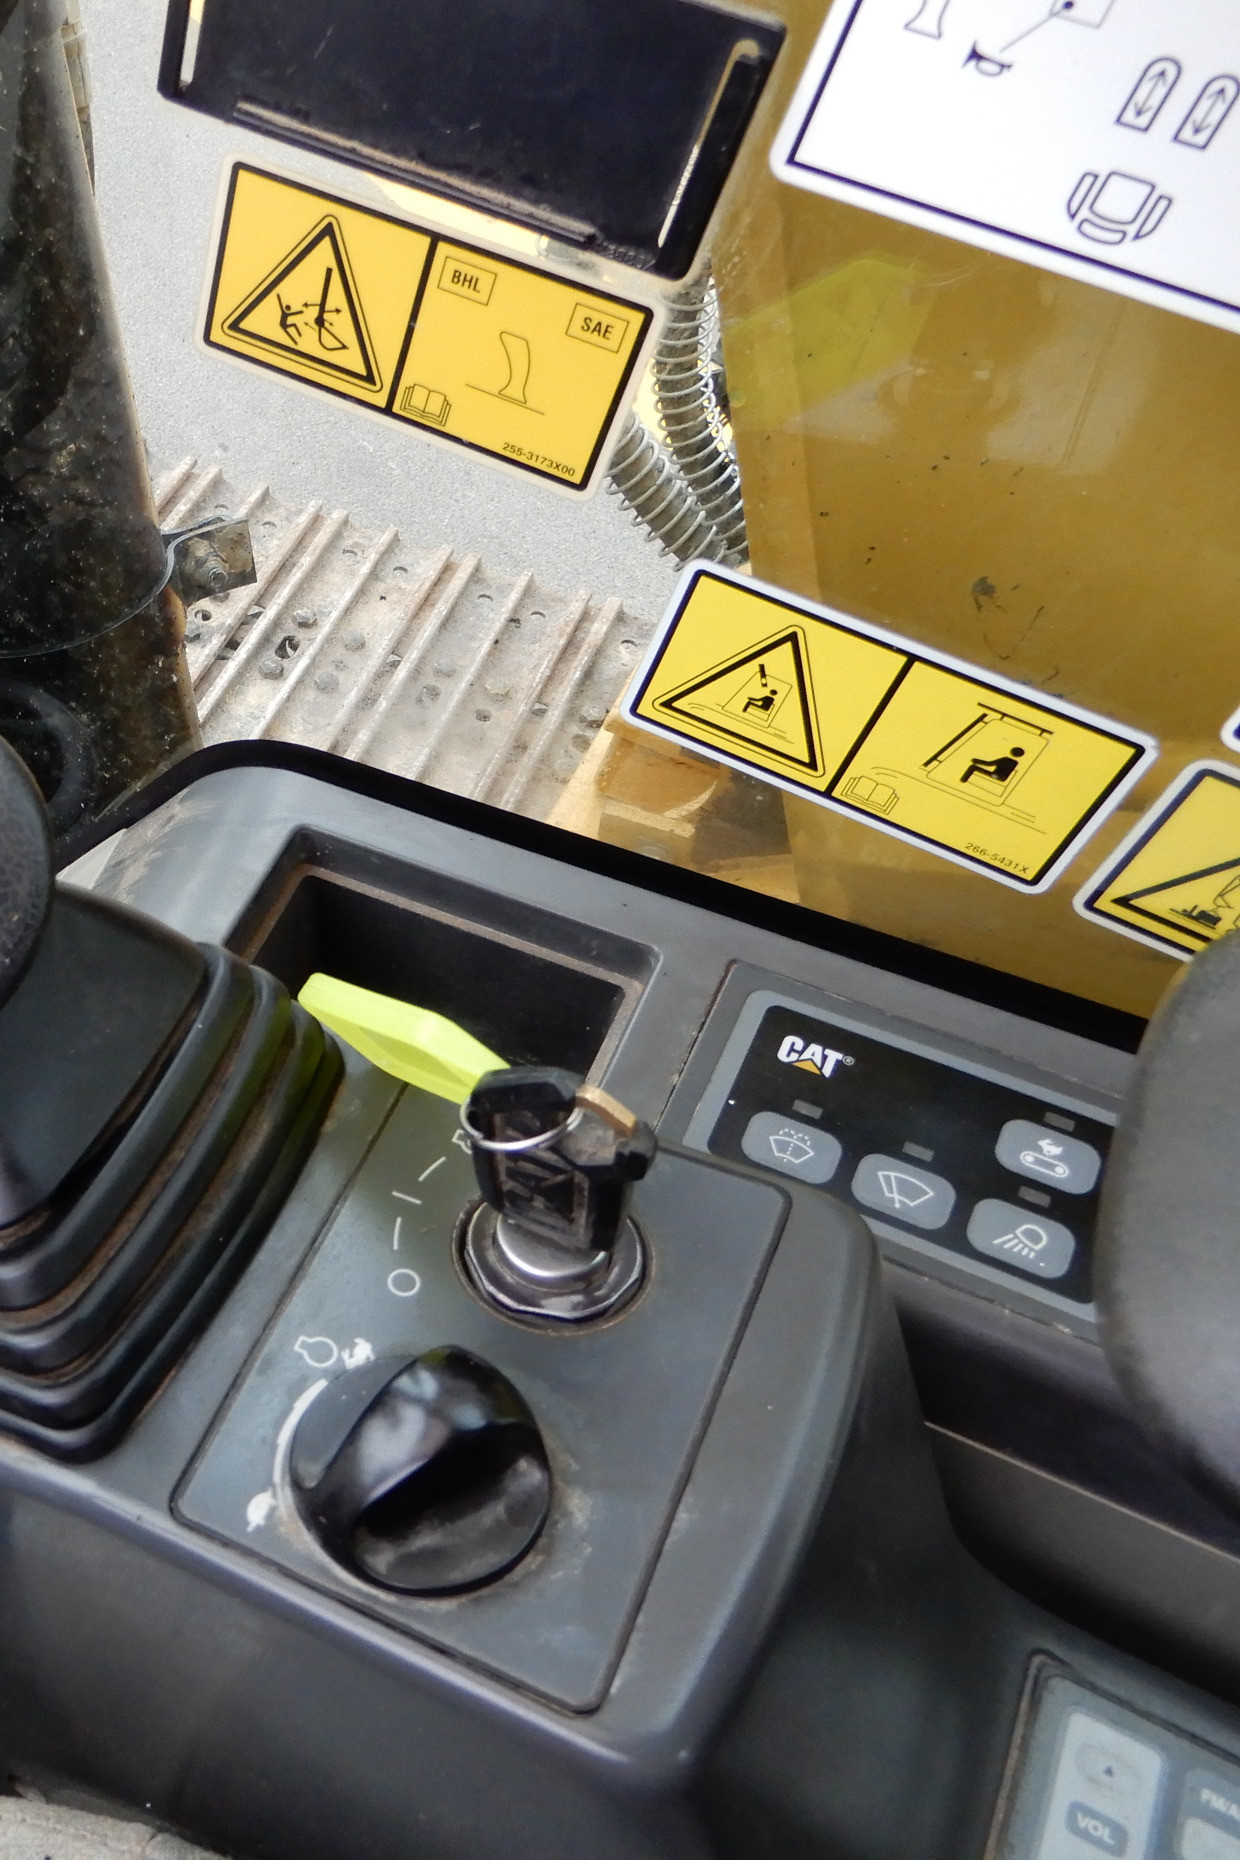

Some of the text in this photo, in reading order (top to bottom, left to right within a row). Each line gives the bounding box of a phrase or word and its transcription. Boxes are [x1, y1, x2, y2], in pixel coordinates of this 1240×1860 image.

[451, 269, 480, 294] BHL
[581, 316, 614, 340] SAE
[502, 442, 575, 477] 255-3173X00
[964, 842, 1029, 874] 266-5431X
[1075, 1809, 1117, 1847] VOL
